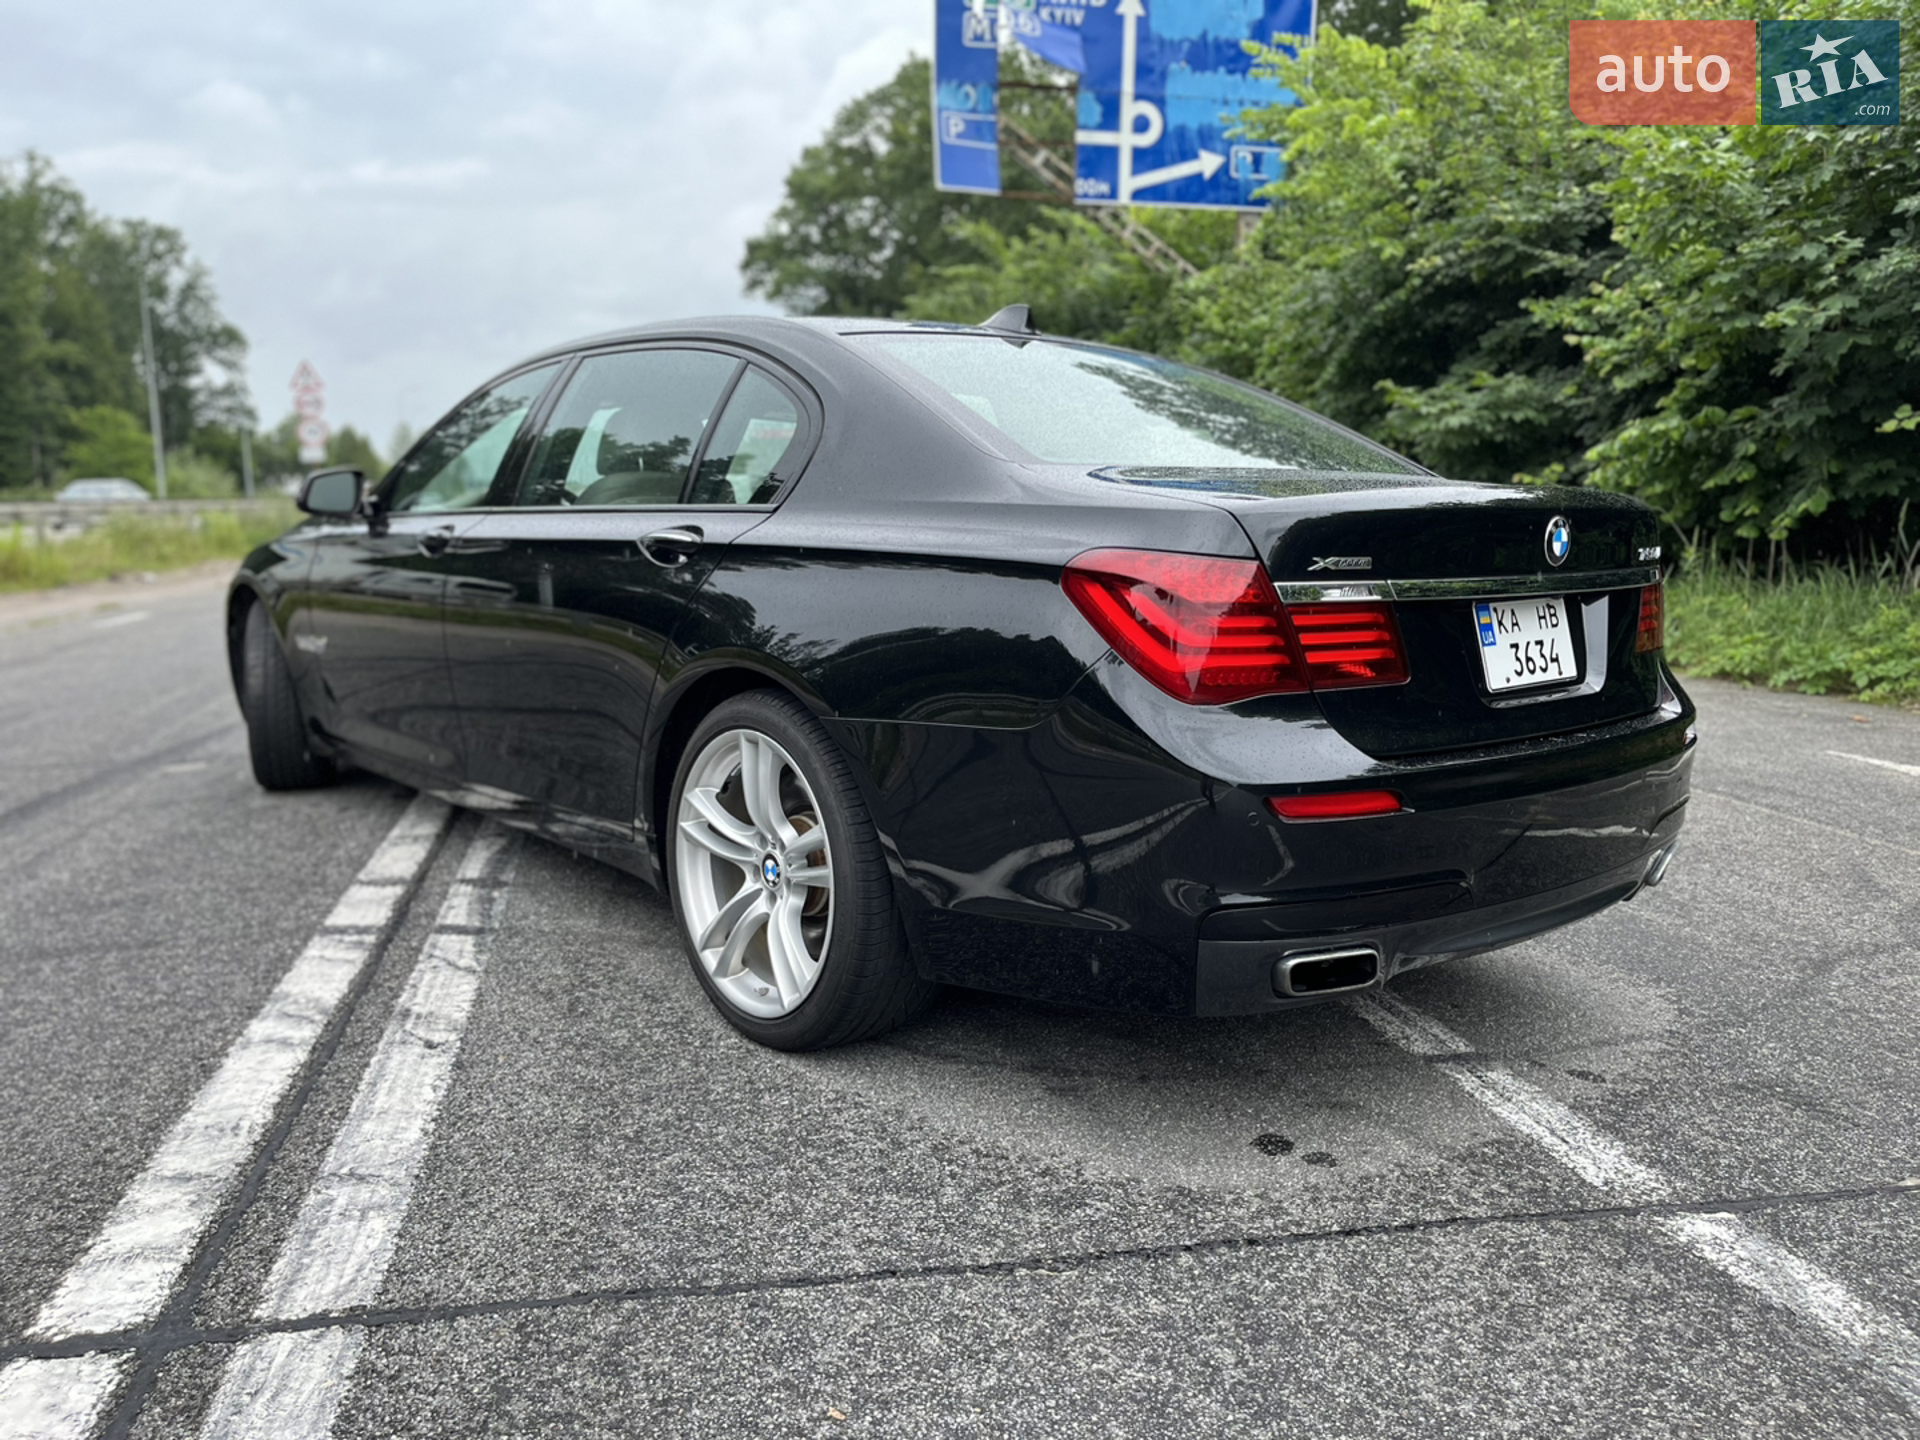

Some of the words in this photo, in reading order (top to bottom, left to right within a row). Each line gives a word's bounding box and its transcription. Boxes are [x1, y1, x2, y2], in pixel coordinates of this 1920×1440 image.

[1039, 7, 1085, 27] KYIV
[1493, 606, 1522, 634] KA
[1535, 603, 1560, 630] HB
[1482, 630, 1495, 645] UA
[1509, 638, 1563, 677] 3634
